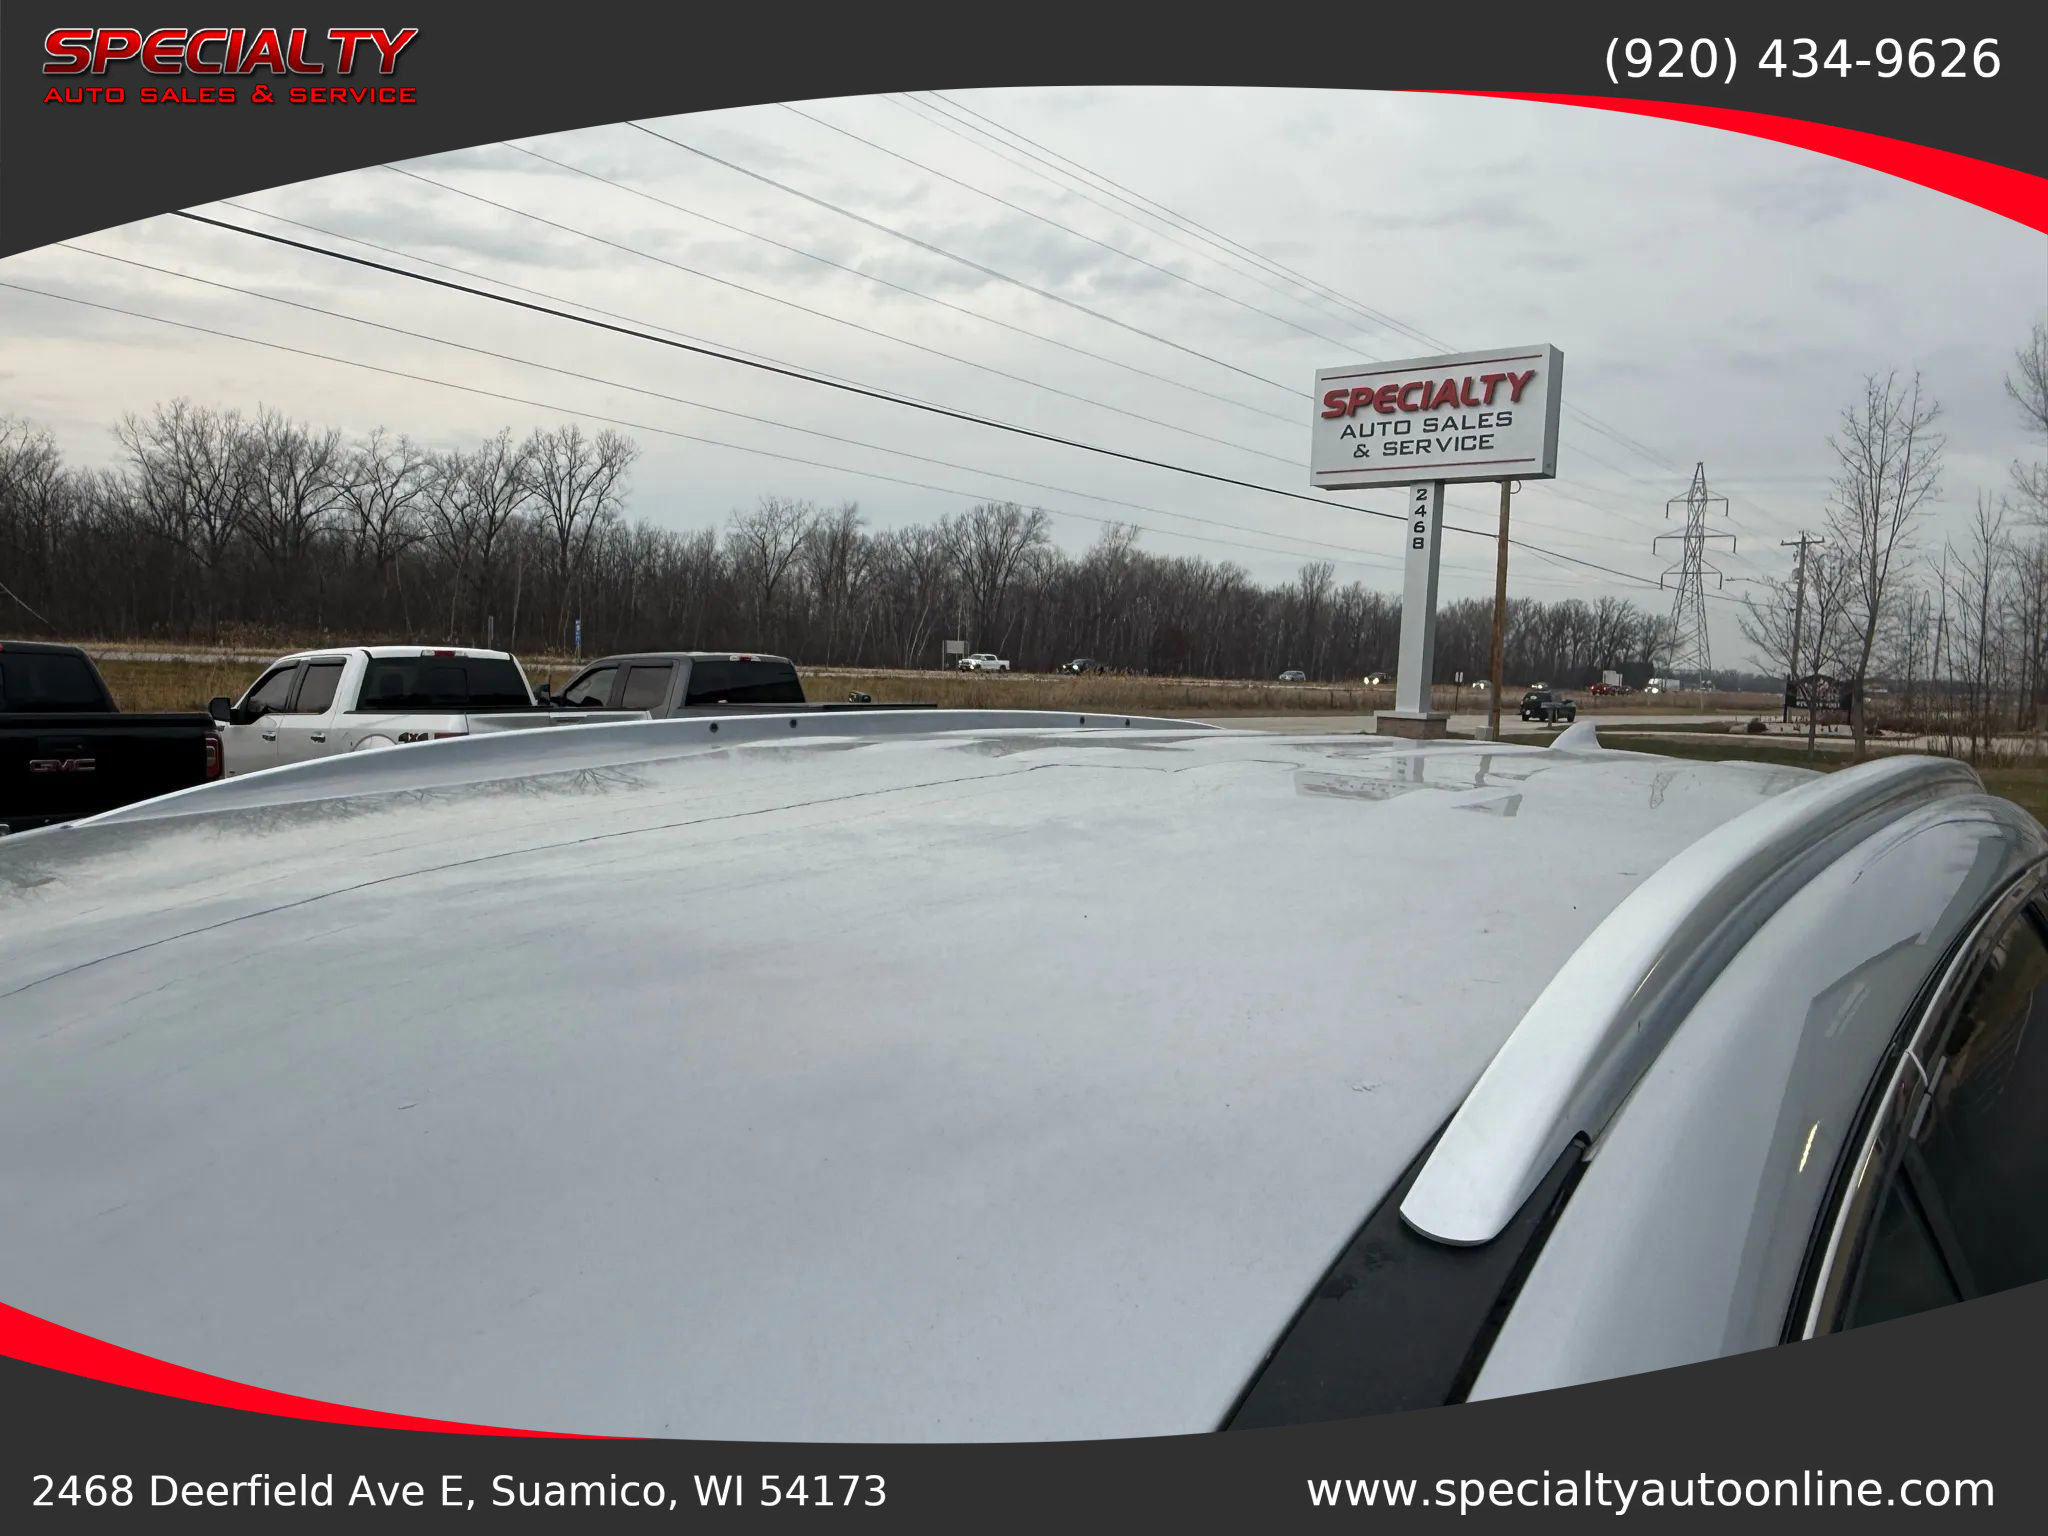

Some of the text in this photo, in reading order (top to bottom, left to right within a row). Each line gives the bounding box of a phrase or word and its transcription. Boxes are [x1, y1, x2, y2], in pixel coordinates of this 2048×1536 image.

[1321, 369, 1536, 420] SPECIALTY
[1340, 410, 1513, 440] AUTO SALES
[1353, 433, 1495, 458] & SERVICE
[1412, 488, 1428, 550] 2468
[29, 758, 96, 773] GMC
